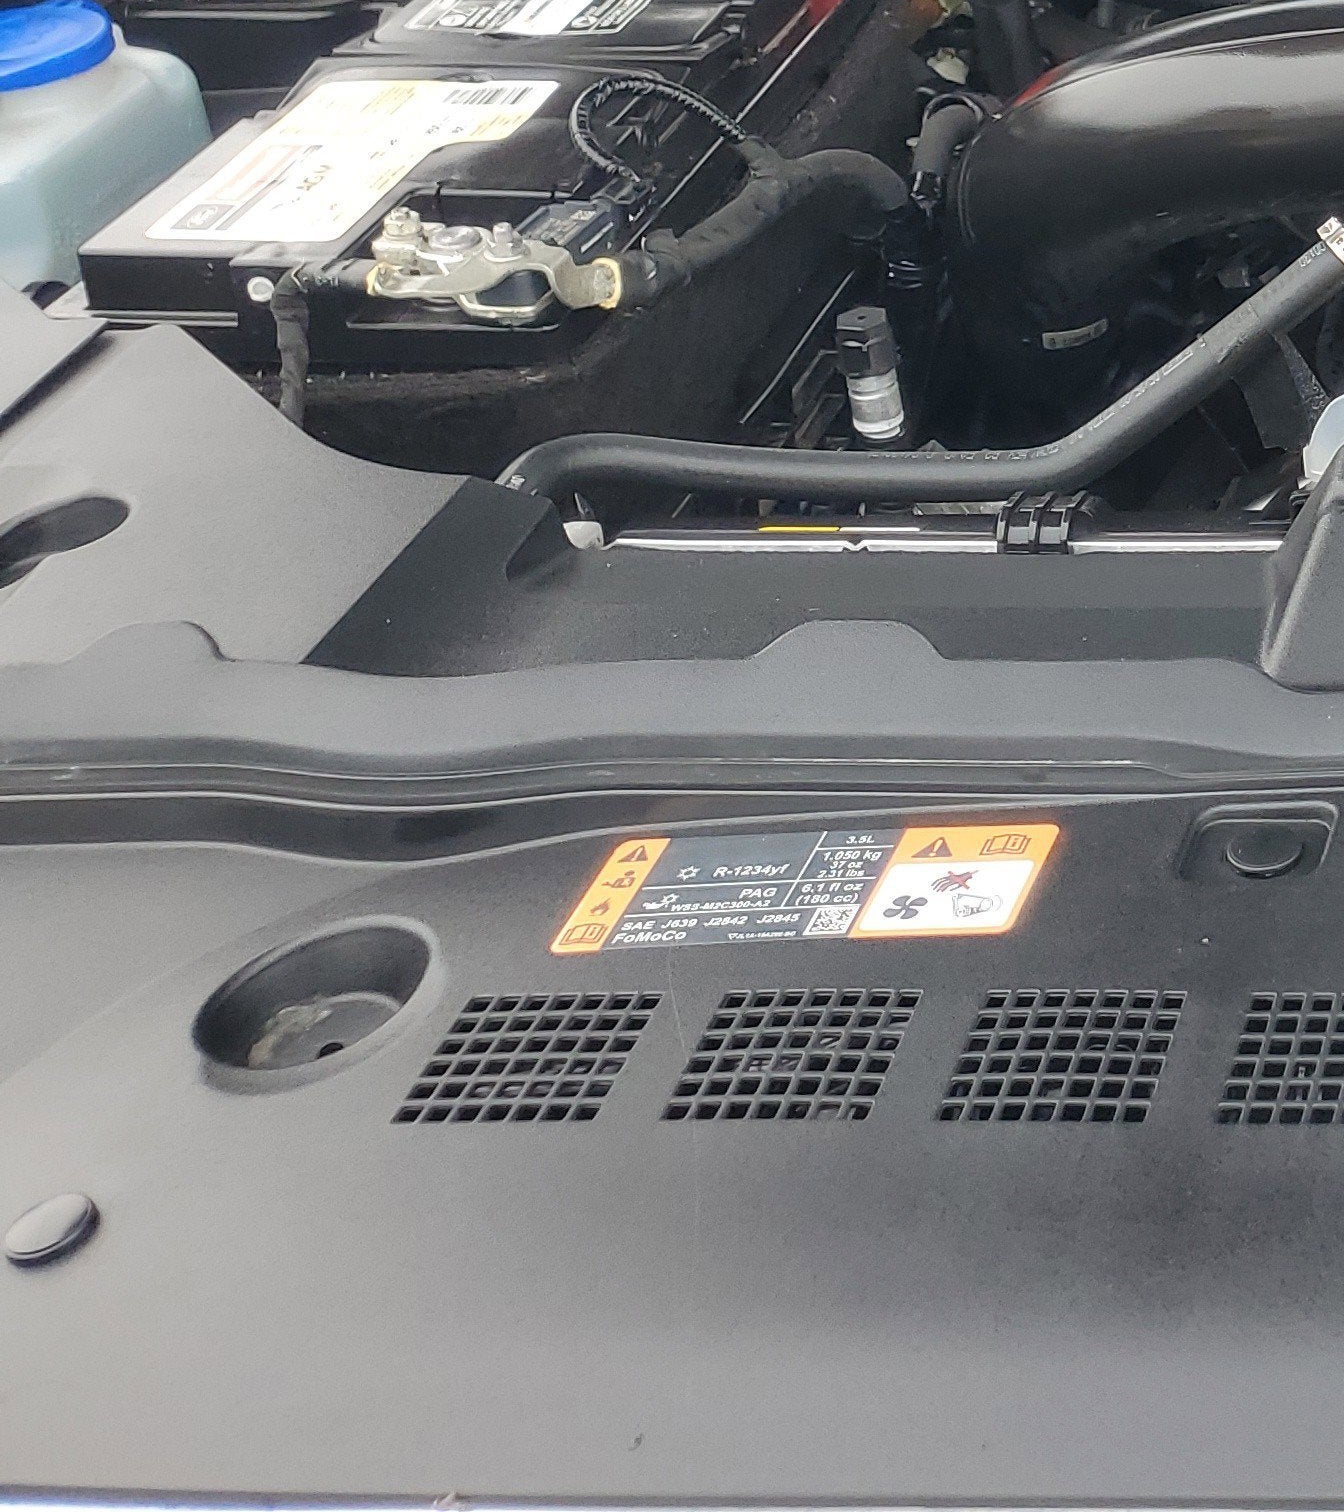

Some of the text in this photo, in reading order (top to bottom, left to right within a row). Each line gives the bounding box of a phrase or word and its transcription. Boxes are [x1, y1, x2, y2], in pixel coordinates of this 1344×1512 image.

[846, 835, 875, 844] 3.5L
[823, 849, 882, 861] 1.050 kg
[829, 860, 864, 869] 37 oz
[712, 863, 791, 879] R-1234yf
[817, 869, 865, 878] 2.31 lbs
[739, 887, 778, 899] PAG
[801, 882, 864, 893] 6.1 fl oz
[795, 892, 859, 906] (180 cc)
[620, 913, 801, 931] SAE J639 J2842 J2845
[611, 931, 687, 944] FoMoCo
